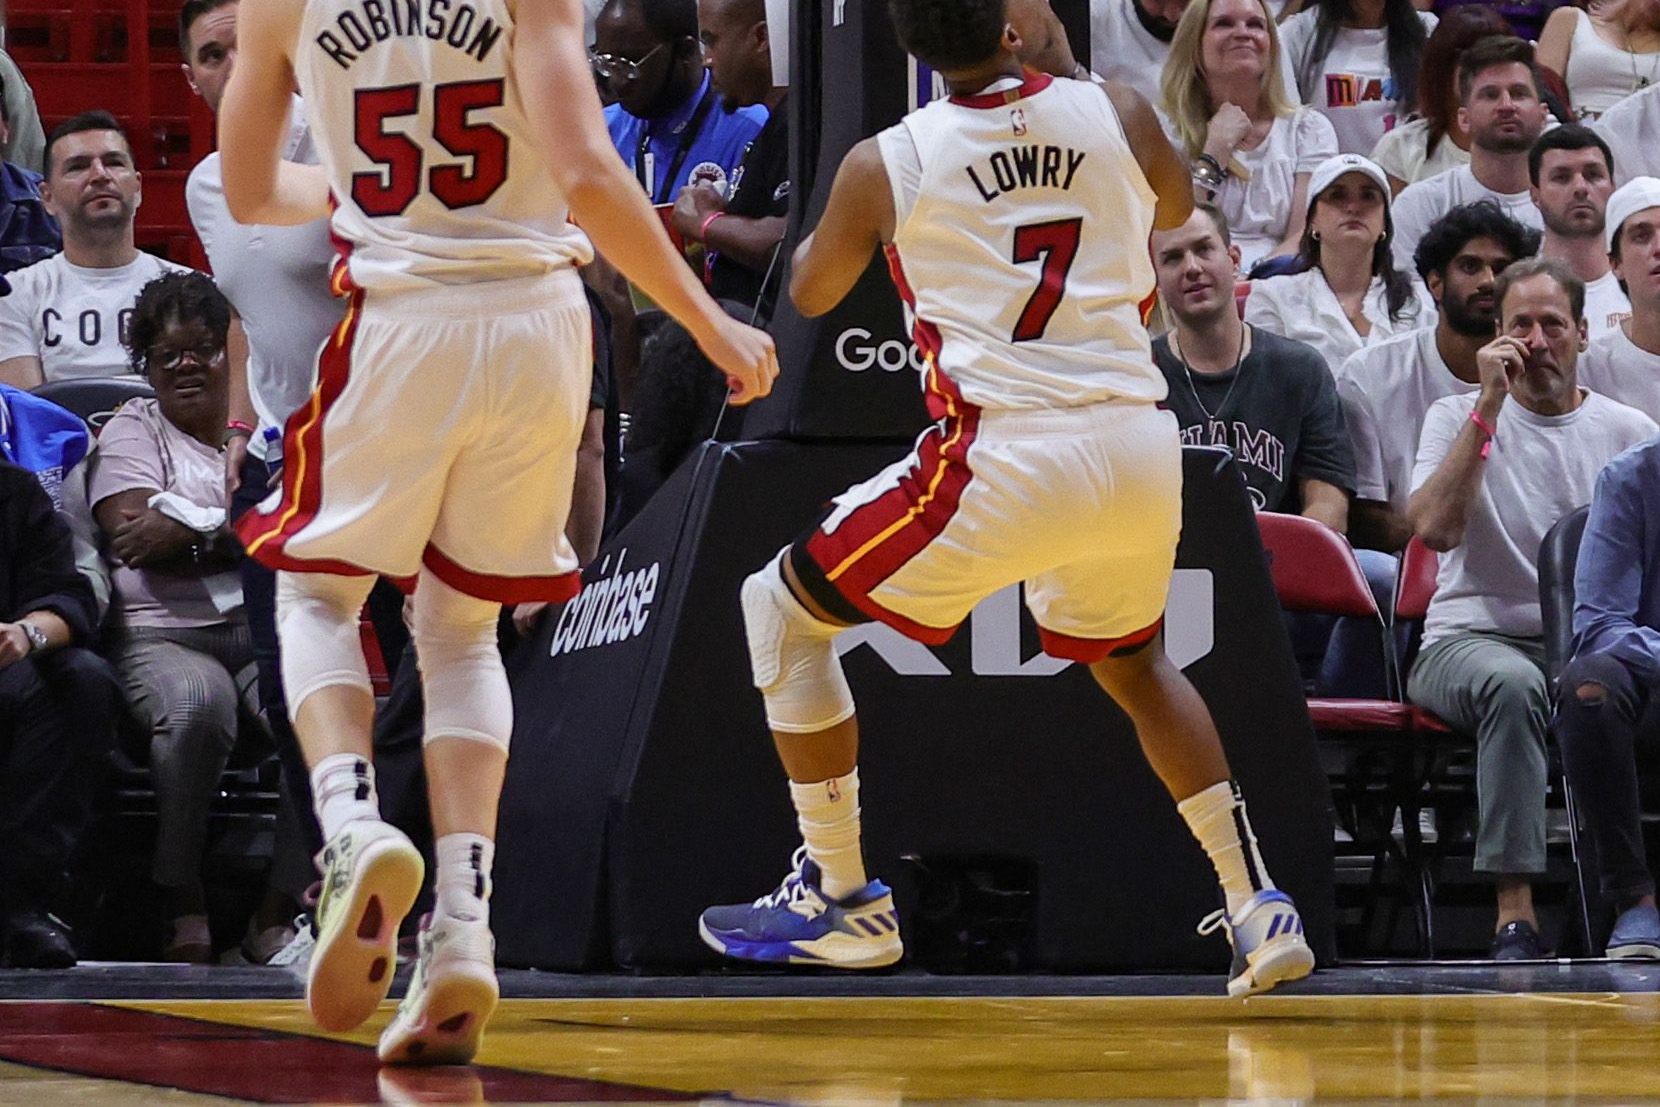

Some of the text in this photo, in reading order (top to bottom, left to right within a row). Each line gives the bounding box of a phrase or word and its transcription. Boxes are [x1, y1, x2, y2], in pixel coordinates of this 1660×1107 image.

[351, 78, 510, 217] 55
[965, 144, 1087, 203] LOWRY
[1011, 217, 1083, 342] 7
[1180, 420, 1284, 482] AMI
[550, 547, 660, 657] coinbase
